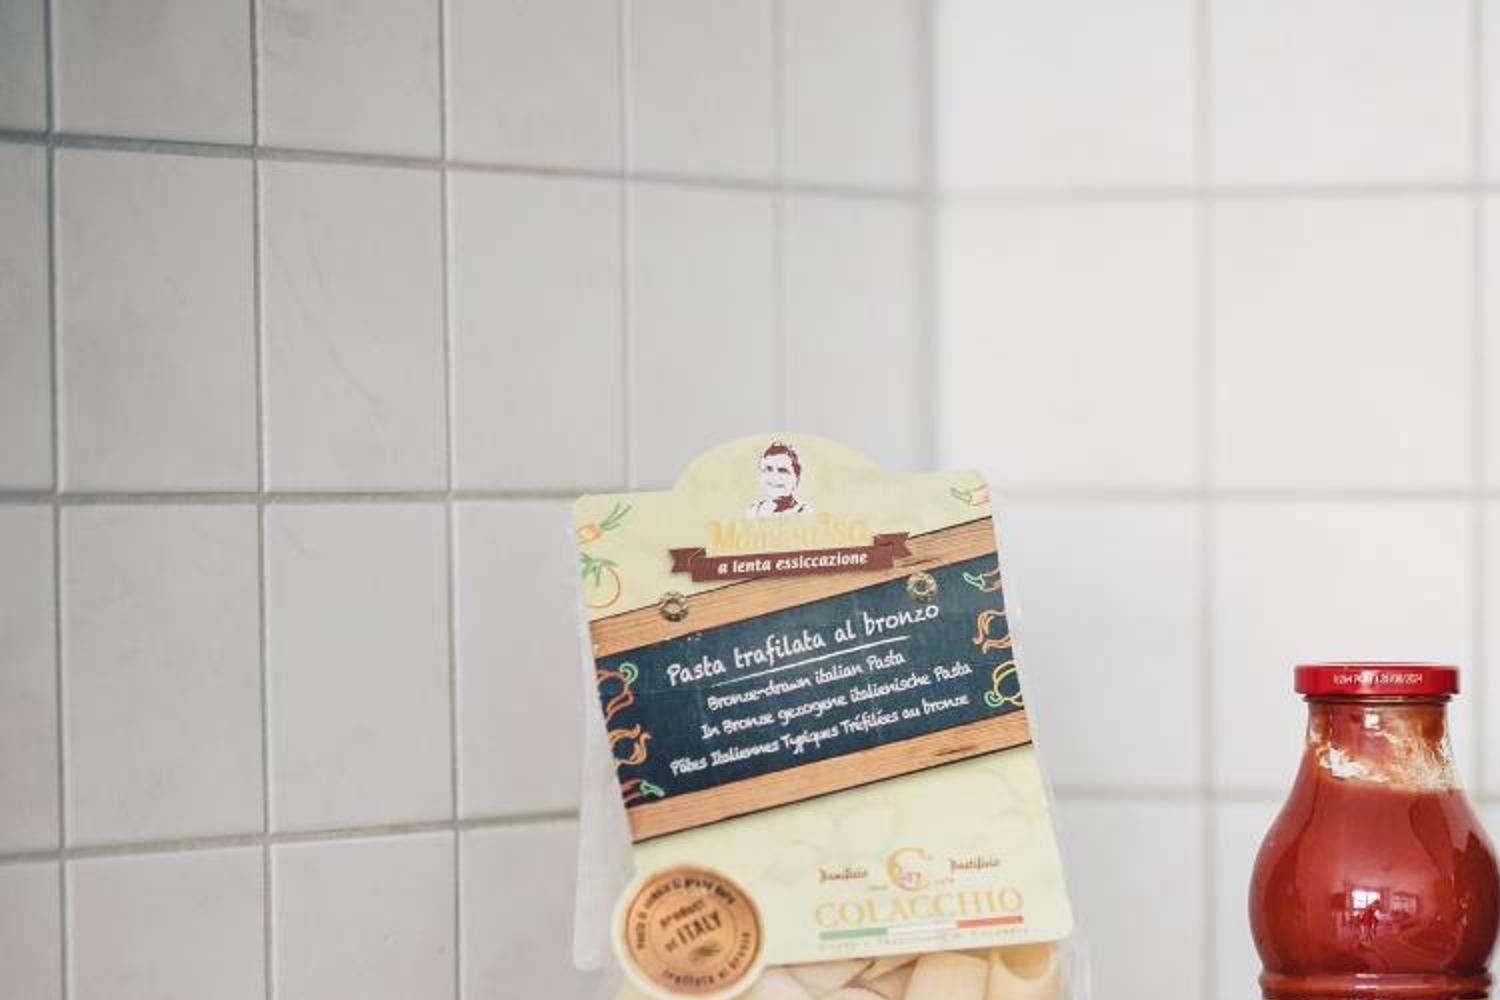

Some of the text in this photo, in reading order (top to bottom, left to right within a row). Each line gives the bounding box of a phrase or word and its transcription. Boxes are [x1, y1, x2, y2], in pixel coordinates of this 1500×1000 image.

[718, 552, 868, 574] a lenta essiccazione
[666, 605, 940, 687] Pasta trafilata al bronzo
[815, 663, 863, 686] italian
[865, 650, 907, 672] Pasta
[700, 661, 973, 741] In Bronze gezogene italienische Pasta
[779, 726, 840, 755] Typiques
[901, 706, 921, 719] au
[921, 694, 971, 715] bronze
[676, 910, 723, 946] ITALY
[815, 887, 1025, 929] COLACCHIO
